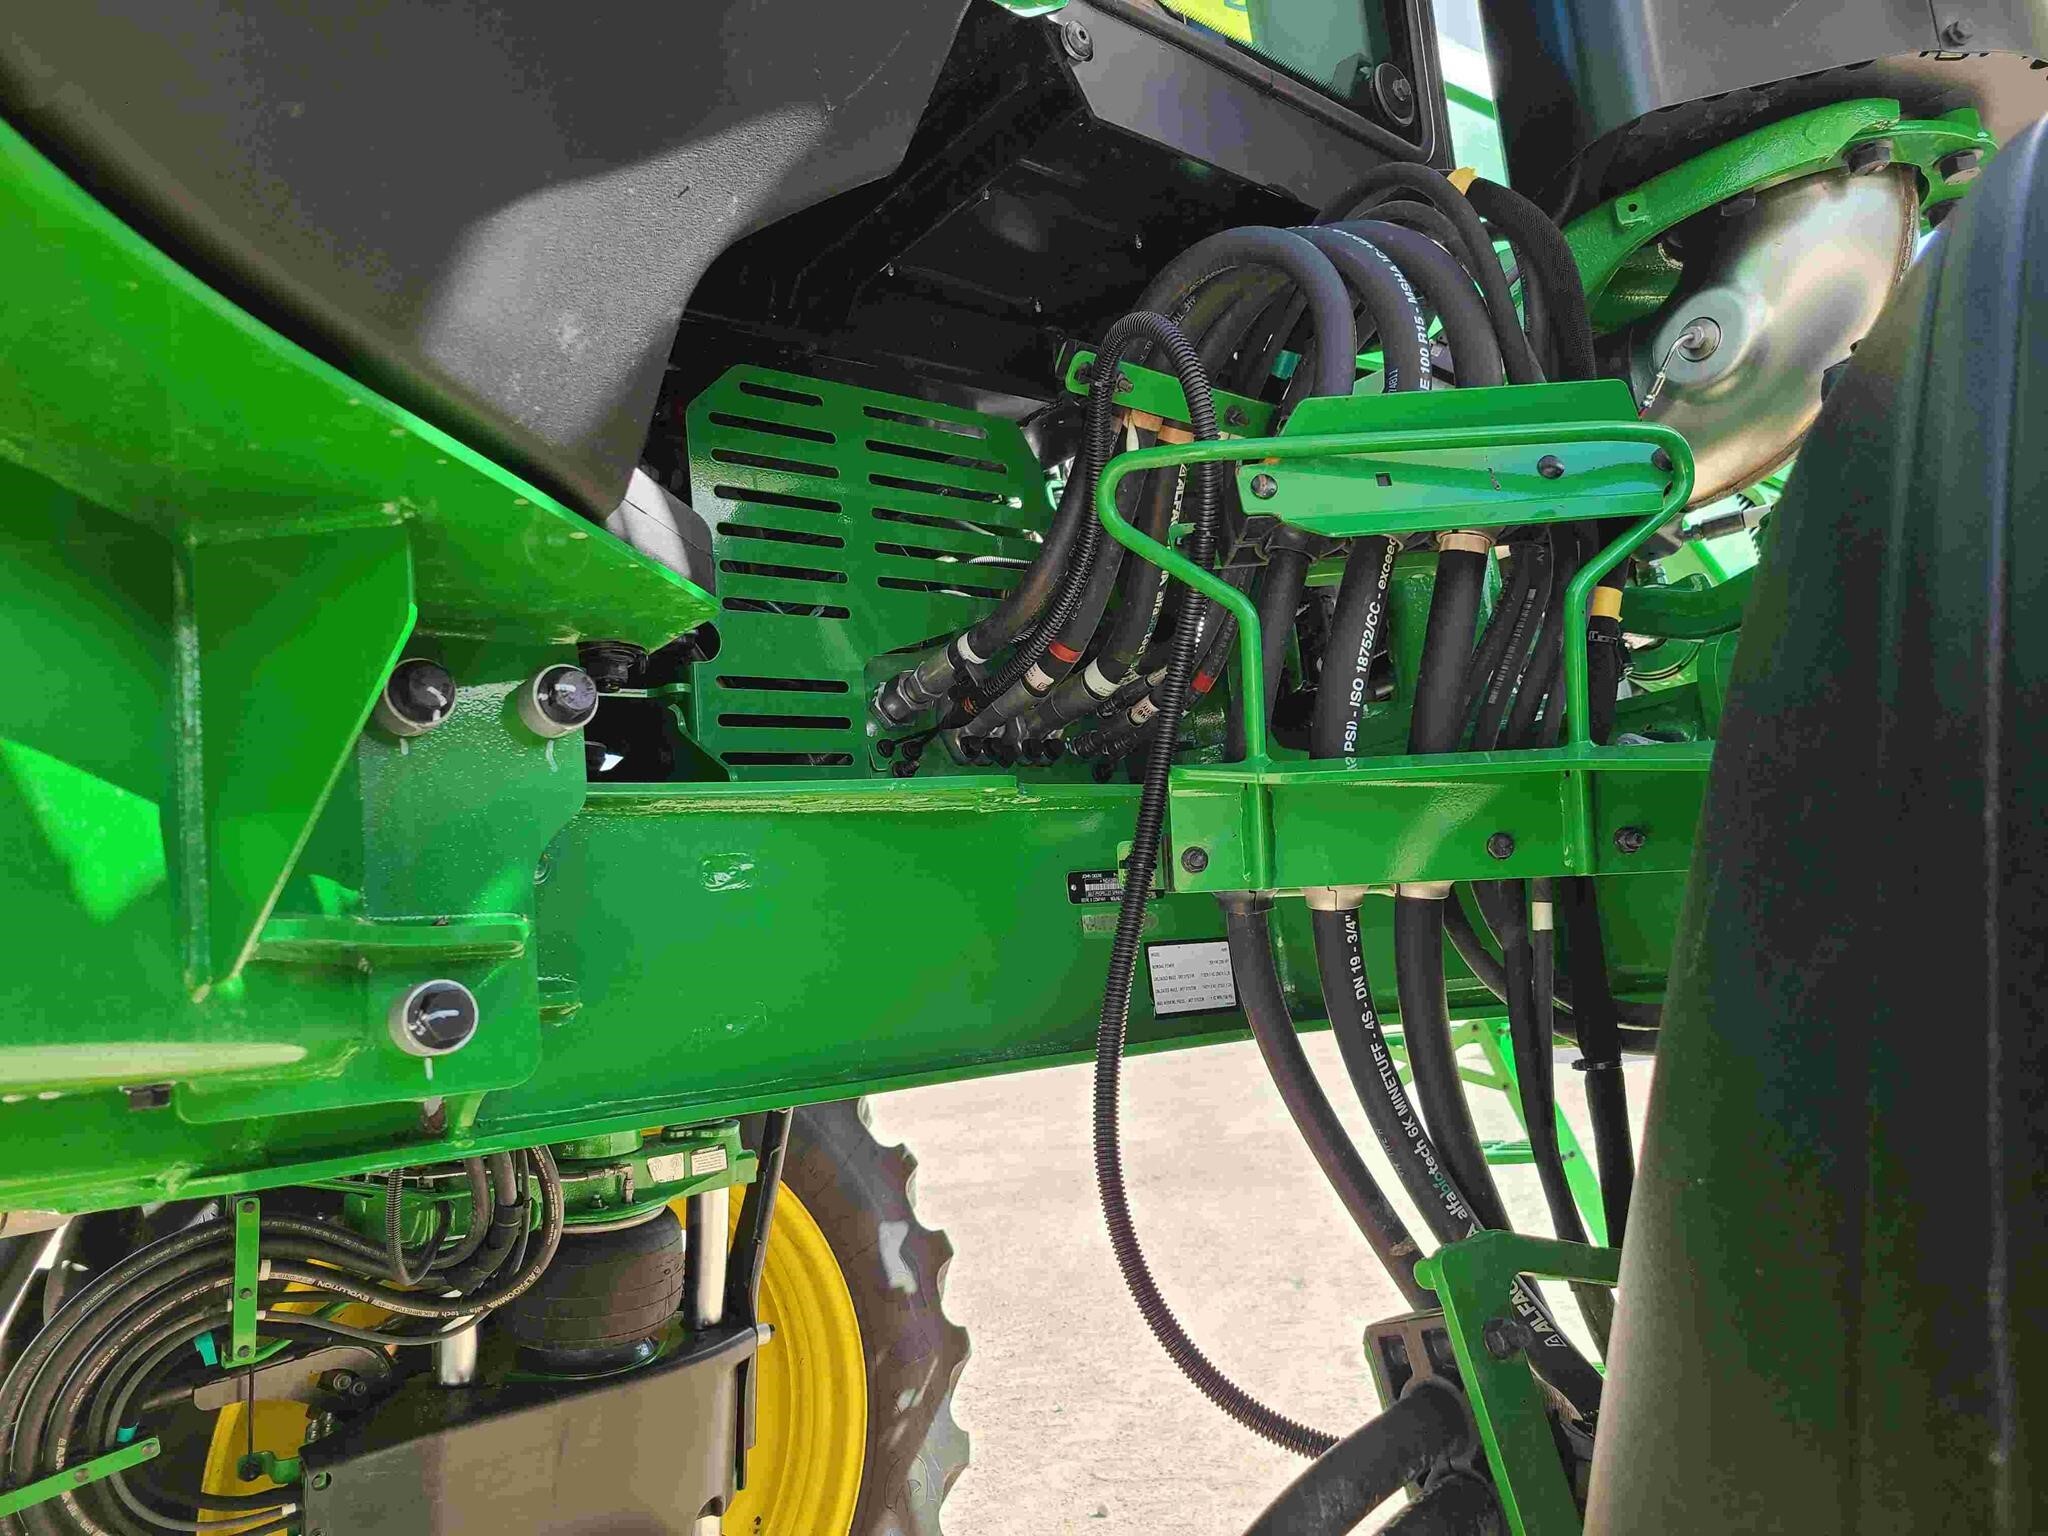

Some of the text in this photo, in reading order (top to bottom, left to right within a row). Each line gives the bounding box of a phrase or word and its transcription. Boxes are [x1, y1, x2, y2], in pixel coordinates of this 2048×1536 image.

[1389, 264, 1418, 304] MSHA
[1414, 315, 1429, 342] R15
[1420, 347, 1431, 374] 100
[1355, 601, 1381, 674] 18752/CC
[1350, 677, 1364, 708] ISO
[1343, 720, 1358, 752] PSI)
[1345, 914, 1359, 943] 3/4"
[1350, 956, 1363, 974] 19
[1352, 977, 1368, 1001] DN
[1361, 1010, 1375, 1030] 4S
[1370, 1043, 1409, 1118] MINETUFF
[1402, 1114, 1420, 1138] 6K
[1413, 1137, 1468, 1220] alfabiotech
[317, 1280, 370, 1303] EVOLUTION
[486, 1269, 538, 1308] ALFAGOMMA
